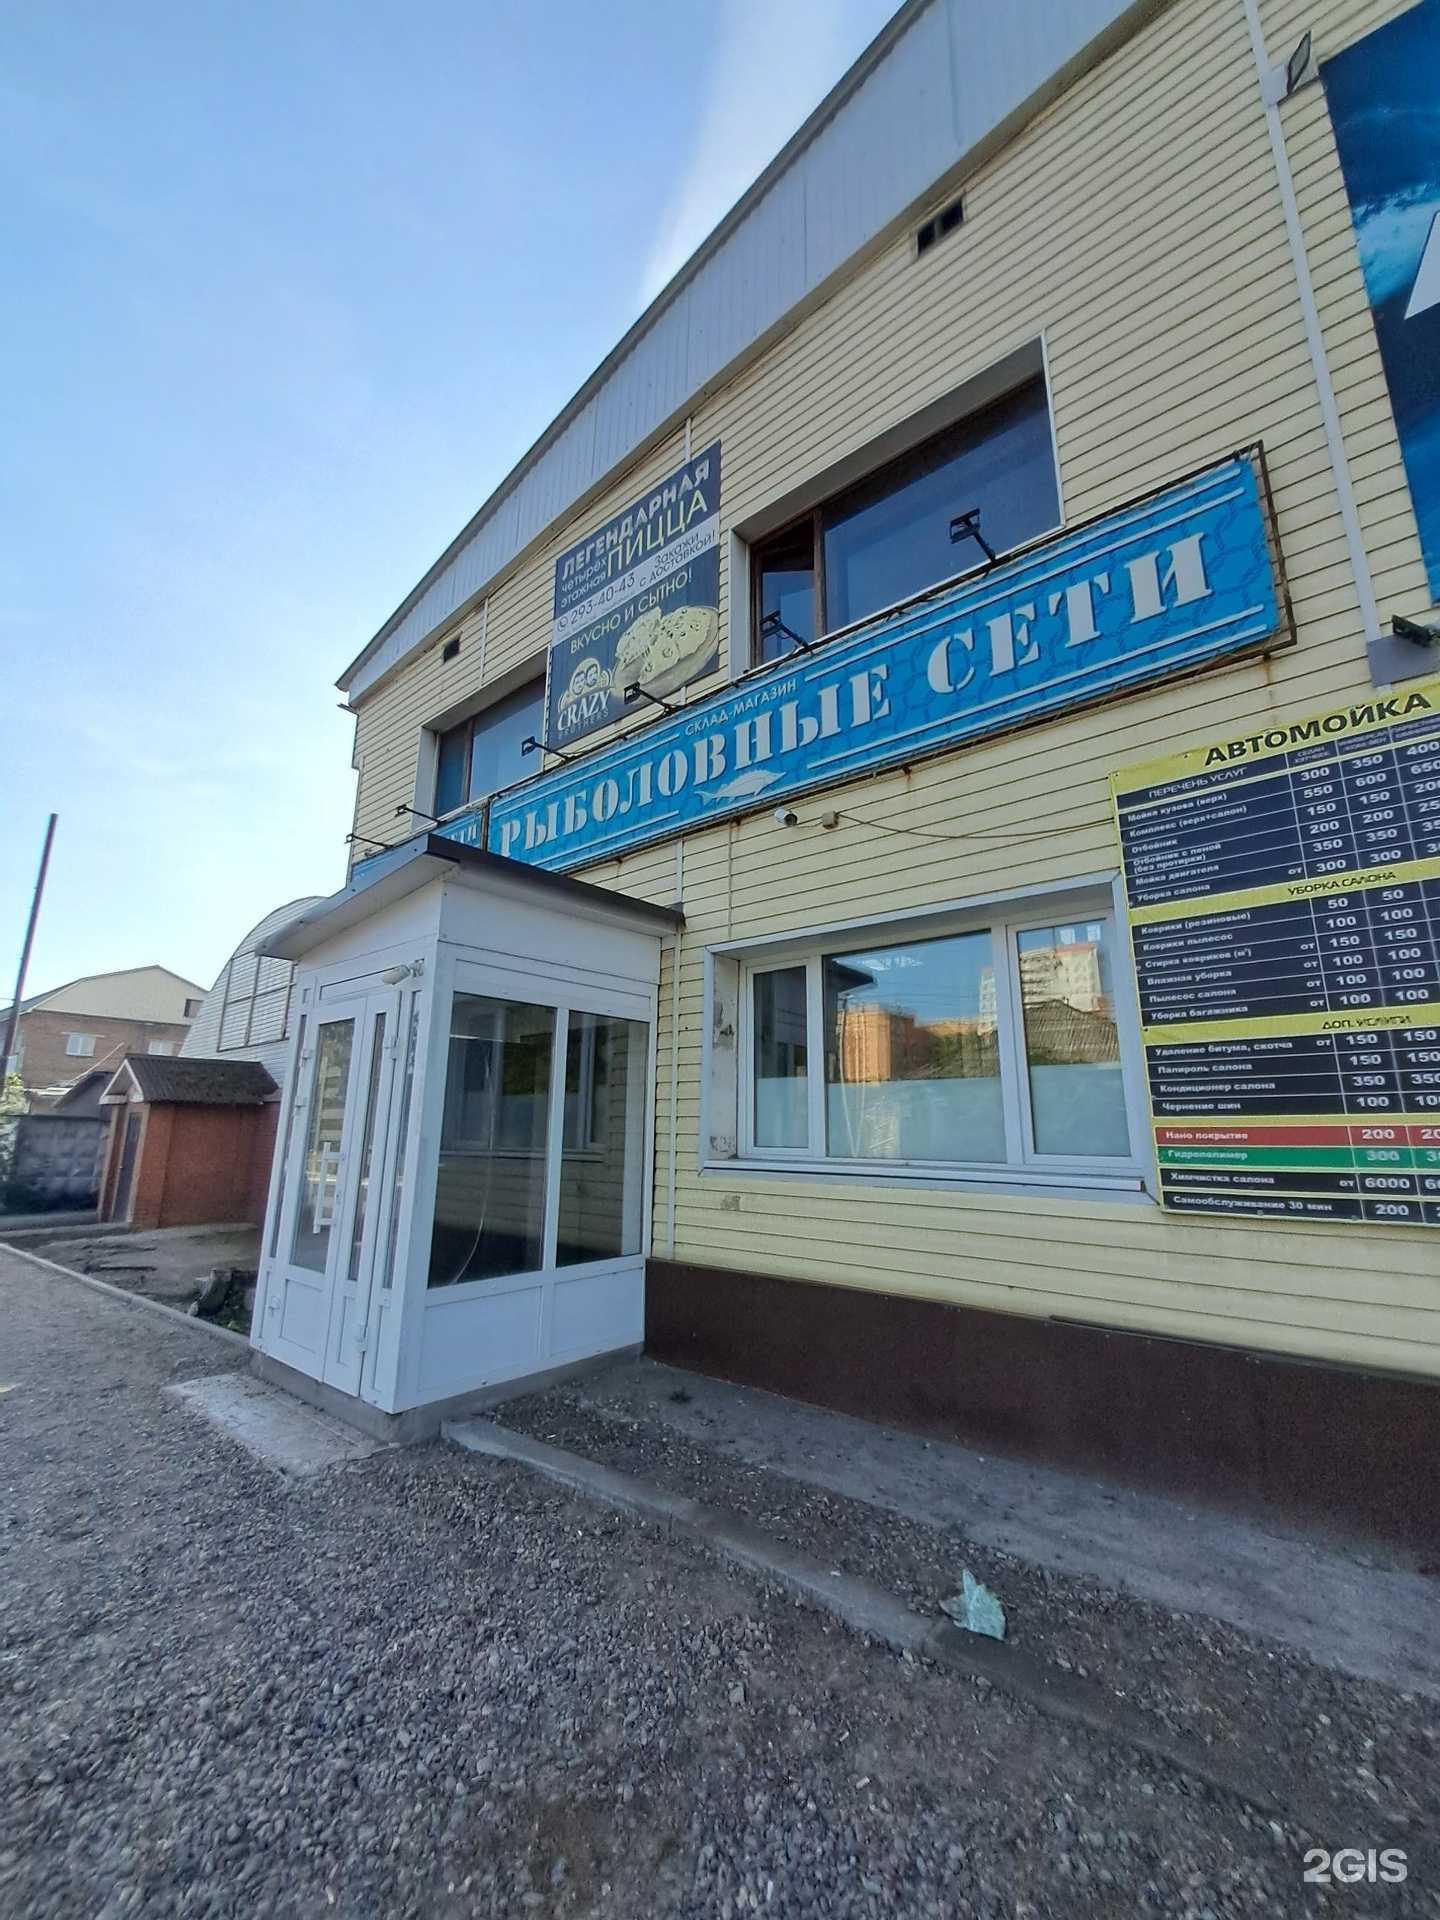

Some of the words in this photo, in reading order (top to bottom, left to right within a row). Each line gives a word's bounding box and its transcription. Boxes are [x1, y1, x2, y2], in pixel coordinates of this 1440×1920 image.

[562, 458, 710, 581] ЛЕГЕНДАРНАЯ
[607, 489, 708, 577] ПИЦЦА
[654, 532, 699, 569] Закажи
[570, 614, 621, 655] ВКУСНО
[624, 604, 635, 623] И
[638, 567, 693, 612] СЫТНО!
[571, 571, 636, 625] 293-40-43
[500, 663, 892, 859] РЫБОЛОВНЫЕ
[926, 531, 1215, 694] СЕТИ
[557, 689, 611, 732] CRAZY
[684, 677, 798, 737] СКЛАД-МАГАЗИН
[1204, 692, 1432, 766] АВТОМОЙКА
[1128, 810, 1158, 822] Мойка
[1160, 801, 1194, 816] кузова
[1196, 793, 1228, 807] (верх)
[1301, 767, 1330, 781] 300
[1352, 755, 1383, 769] 350
[1406, 741, 1440, 755] 400
[1130, 822, 1177, 838] Комплекс
[1304, 785, 1333, 798] 550
[1355, 773, 1387, 787] 600
[1411, 761, 1440, 775] 650
[1149, 777, 1208, 798] ПЕРЕЧЕНЬ
[1210, 767, 1248, 782] УСЛУГ
[1132, 839, 1178, 854] Отбойник
[1307, 802, 1337, 816] 150
[1359, 792, 1391, 805] 150
[1414, 780, 1440, 793] 20
[1190, 843, 1221, 855] пеной
[1309, 821, 1340, 834] 200
[1363, 809, 1394, 824] 200
[1136, 873, 1166, 886] Мойка
[1168, 865, 1219, 880] двигателя
[1312, 839, 1343, 852] 350
[1366, 828, 1397, 842] 350
[1137, 889, 1172, 902] Уборка
[1174, 884, 1211, 895] салона
[1287, 867, 1303, 875] от
[1316, 859, 1346, 872] 300
[1370, 850, 1401, 863] 300
[1288, 880, 1340, 896] УБОРКА
[1341, 871, 1397, 887] САЛОНА
[1141, 923, 1182, 935] Коврики
[1185, 912, 1251, 929] (резиновые)
[1327, 897, 1348, 909] 50
[1382, 889, 1404, 901] 50
[1143, 941, 1185, 951] Коврики
[1187, 933, 1233, 945] пылесос
[1326, 916, 1356, 928] 100
[1381, 908, 1413, 920] 100
[1145, 957, 1180, 969] Стирка
[1182, 952, 1232, 964] ковриков
[1300, 943, 1315, 951] от
[1329, 935, 1360, 947] 150
[1384, 928, 1417, 940] 150
[1147, 974, 1193, 985] Влажная
[1195, 970, 1232, 981] уборка
[1333, 954, 1363, 966] 100
[1388, 948, 1421, 960] 100
[1149, 992, 1195, 1003] Пылесос
[1198, 988, 1237, 999] салона
[1336, 974, 1367, 985] 100
[1392, 968, 1425, 980] 100
[1152, 1009, 1187, 1020] Уборка
[1189, 1005, 1248, 1017] багажника
[1310, 999, 1324, 1007] от
[1339, 993, 1371, 1005] 100
[1395, 989, 1429, 1000] 100
[1155, 1047, 1206, 1056] Удаление
[1208, 1043, 1251, 1053] битума,
[1253, 1041, 1293, 1050] скотча
[1346, 1033, 1378, 1045] 150
[1402, 1030, 1437, 1041] 150
[1322, 1019, 1354, 1030] ДОП.
[1356, 1015, 1412, 1027] УСЛУГИ
[1160, 1084, 1232, 1093] Кондиционер
[1234, 1082, 1276, 1090] салона
[1352, 1075, 1386, 1086] 350
[1410, 1072, 1440, 1085] 350
[1212, 1063, 1253, 1072] салона
[1349, 1054, 1382, 1065] 150
[1406, 1051, 1440, 1063] 150
[1162, 1102, 1215, 1111] Чернение
[1217, 1102, 1241, 1110] шин
[1356, 1096, 1390, 1107] 100
[1414, 1095, 1440, 1106] 10
[1166, 1131, 1193, 1140] Нано
[1195, 1131, 1249, 1141] покрытие
[1361, 1128, 1396, 1140] 200
[1366, 1150, 1400, 1161] 300
[1170, 1172, 1230, 1182] Химчистка
[1232, 1175, 1275, 1184] салона
[1364, 1177, 1411, 1189] 6000
[1173, 1195, 1286, 1210] Самообслуживание
[1289, 1201, 1303, 1210] 30
[1375, 1204, 1410, 1216] 200
